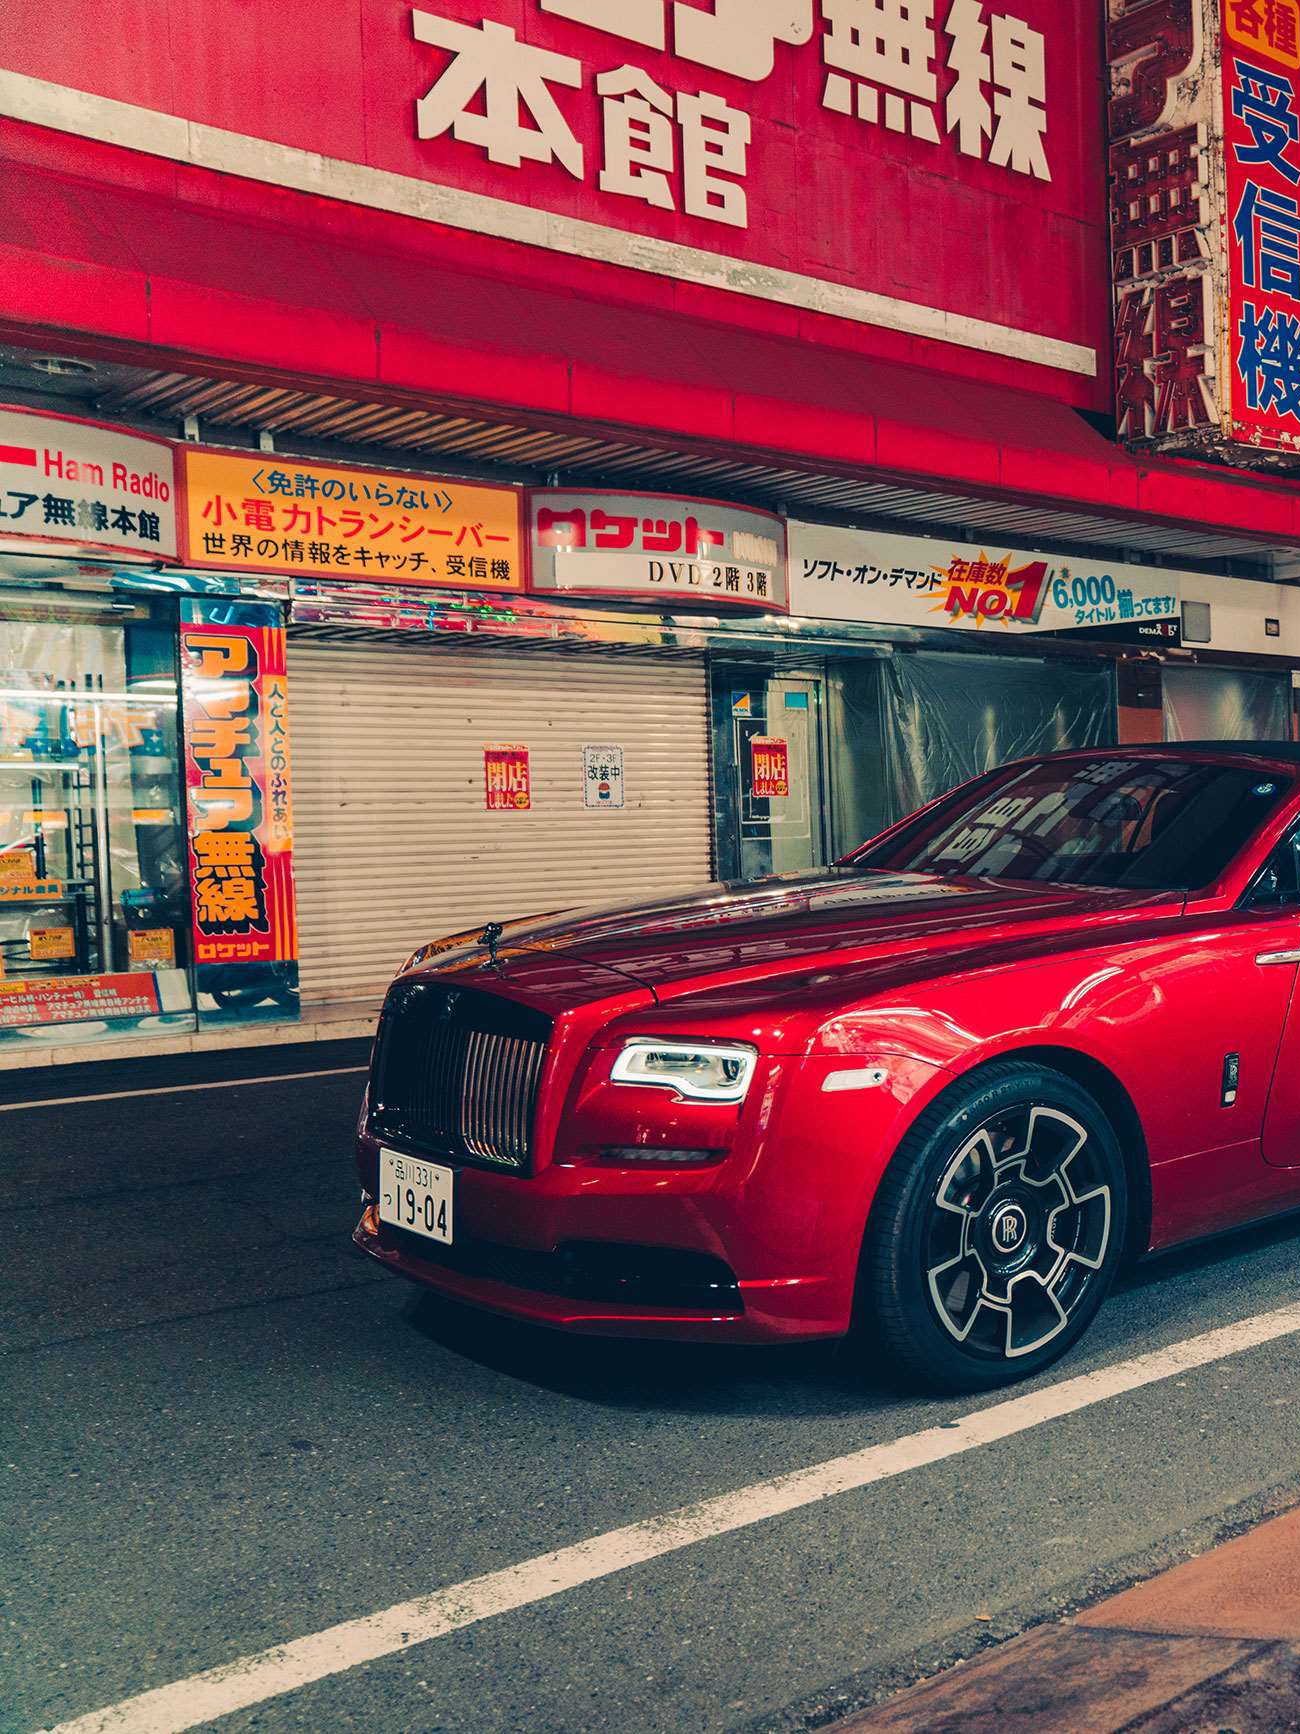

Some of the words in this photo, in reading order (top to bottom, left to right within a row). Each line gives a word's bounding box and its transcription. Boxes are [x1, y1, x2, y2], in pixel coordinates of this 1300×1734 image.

[412, 8, 751, 229] 本館
[44, 448, 104, 487] Ham
[111, 462, 170, 503] Radio
[202, 495, 511, 548] 小電力トランシーバー
[537, 507, 725, 554] ロケット
[202, 532, 511, 581] 世界の情報をキャッチ、受信機
[803, 558, 942, 591] ソフト・オン・デマンド
[947, 558, 1007, 587] 在庫数
[649, 560, 701, 586] DVD
[712, 566, 740, 592] 2階
[746, 571, 768, 597] 3階
[1052, 574, 1116, 609] 6,000
[1074, 607, 1116, 625] タイトル
[184, 636, 260, 922] アマチュア無線
[267, 683, 290, 841] 人と人とのふれあい
[487, 761, 527, 792] 閉店
[587, 765, 620, 781] 改装中
[754, 753, 786, 780] 閉店
[197, 942, 271, 960] ロケット
[394, 1159, 415, 1185] 品川
[415, 1166, 433, 1189] 331
[383, 1193, 392, 1206] つ
[397, 1184, 448, 1237] 19-04
